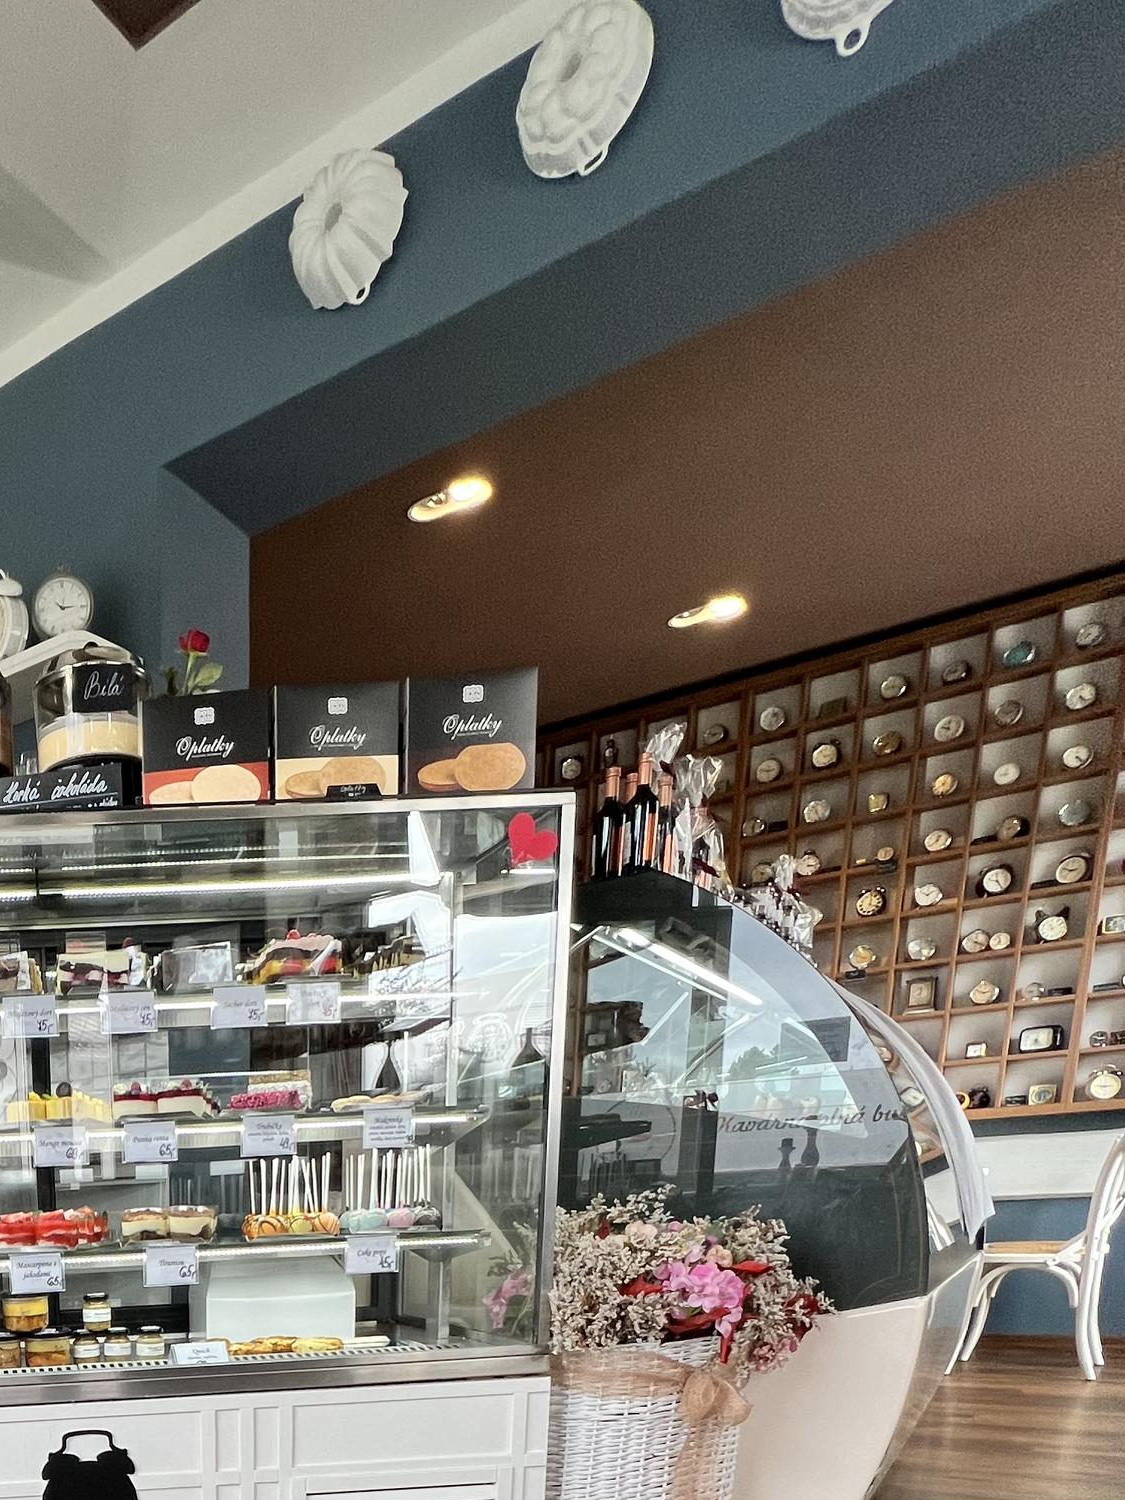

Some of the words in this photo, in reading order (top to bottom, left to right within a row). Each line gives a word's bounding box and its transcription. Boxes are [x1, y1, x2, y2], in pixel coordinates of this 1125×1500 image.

[309, 725, 366, 751] Oplatky
[442, 712, 503, 741] Oplatky
[176, 735, 235, 761] Oplatky
